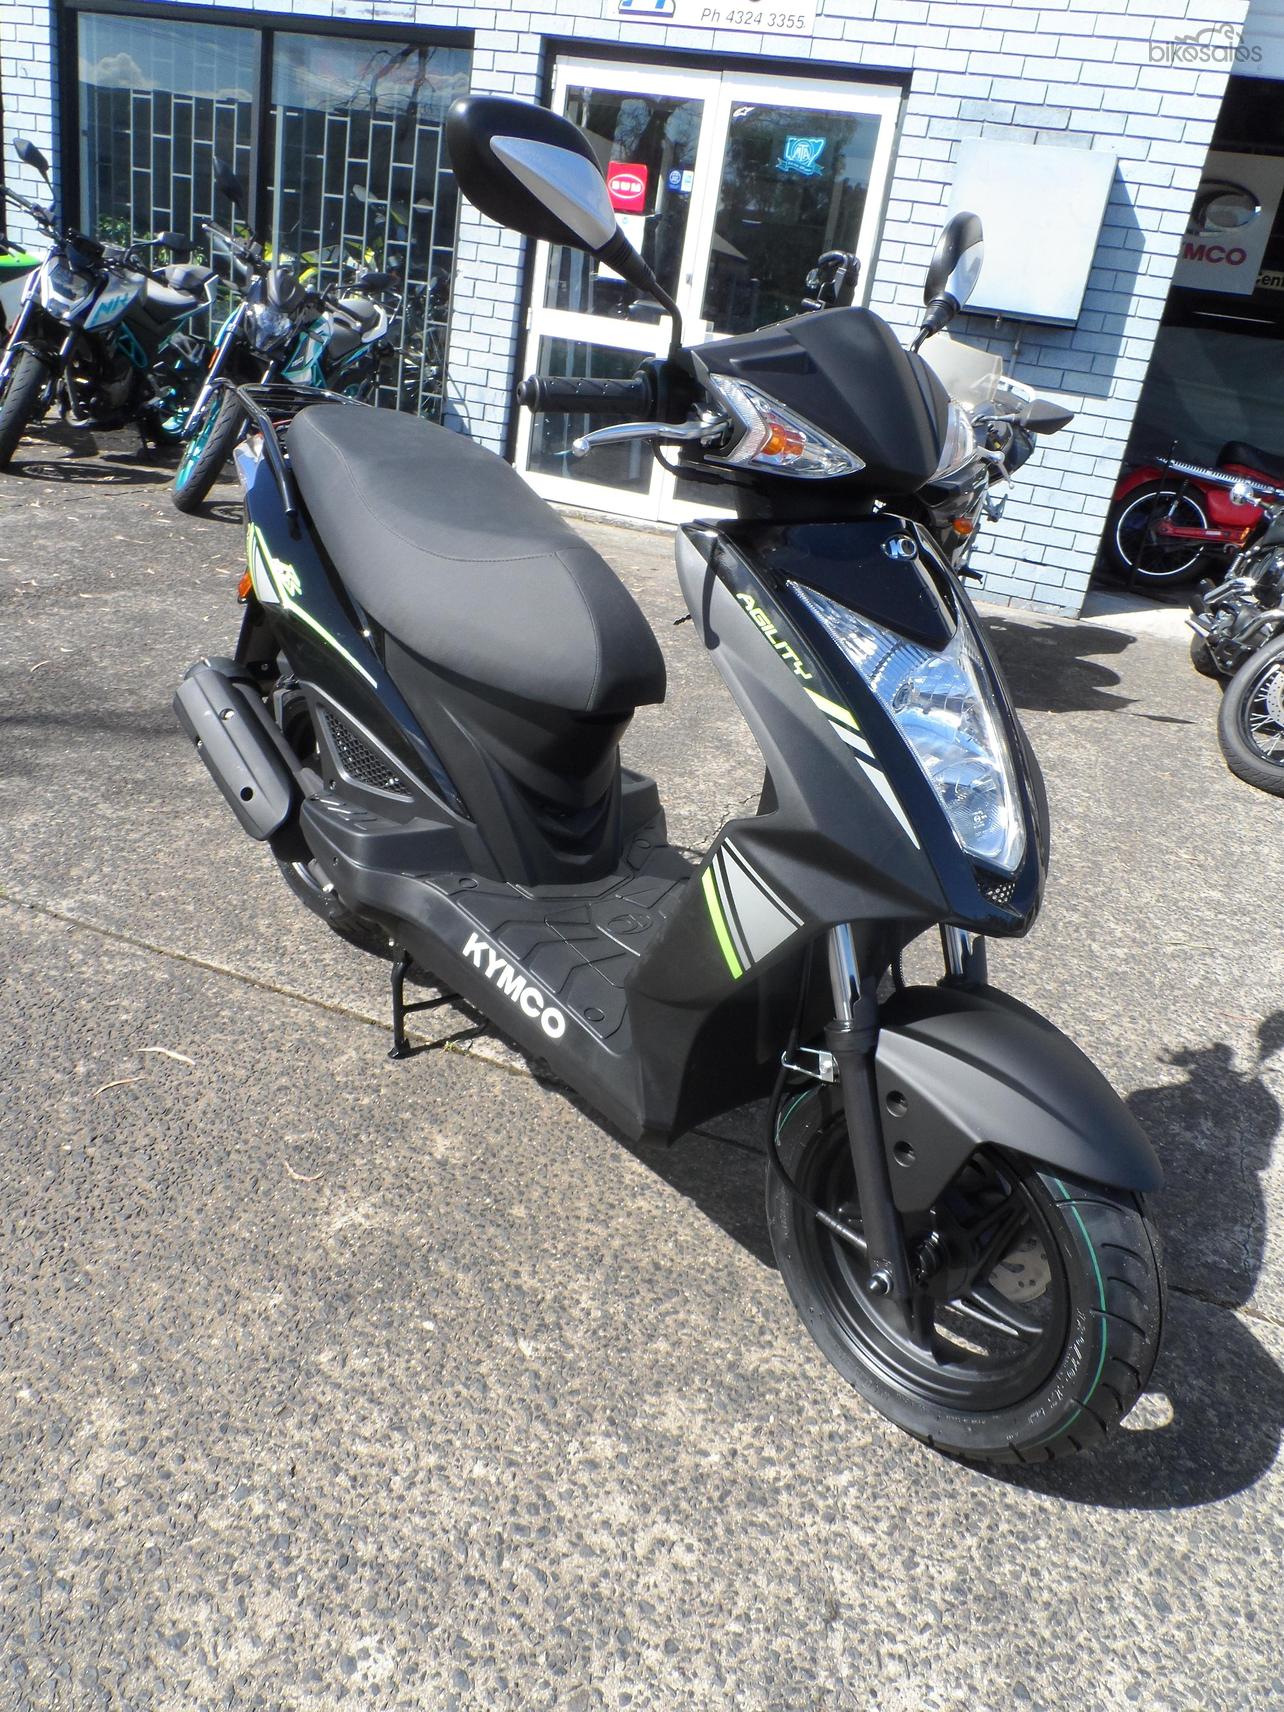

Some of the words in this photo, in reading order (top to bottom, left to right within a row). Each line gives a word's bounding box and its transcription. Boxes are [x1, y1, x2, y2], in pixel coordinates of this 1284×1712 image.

[701, 7, 720, 22] Ph
[726, 10, 763, 25] 4324
[1181, 243, 1248, 266] MCO
[735, 592, 813, 680] AGILITY
[461, 931, 566, 1039] KYMCO
